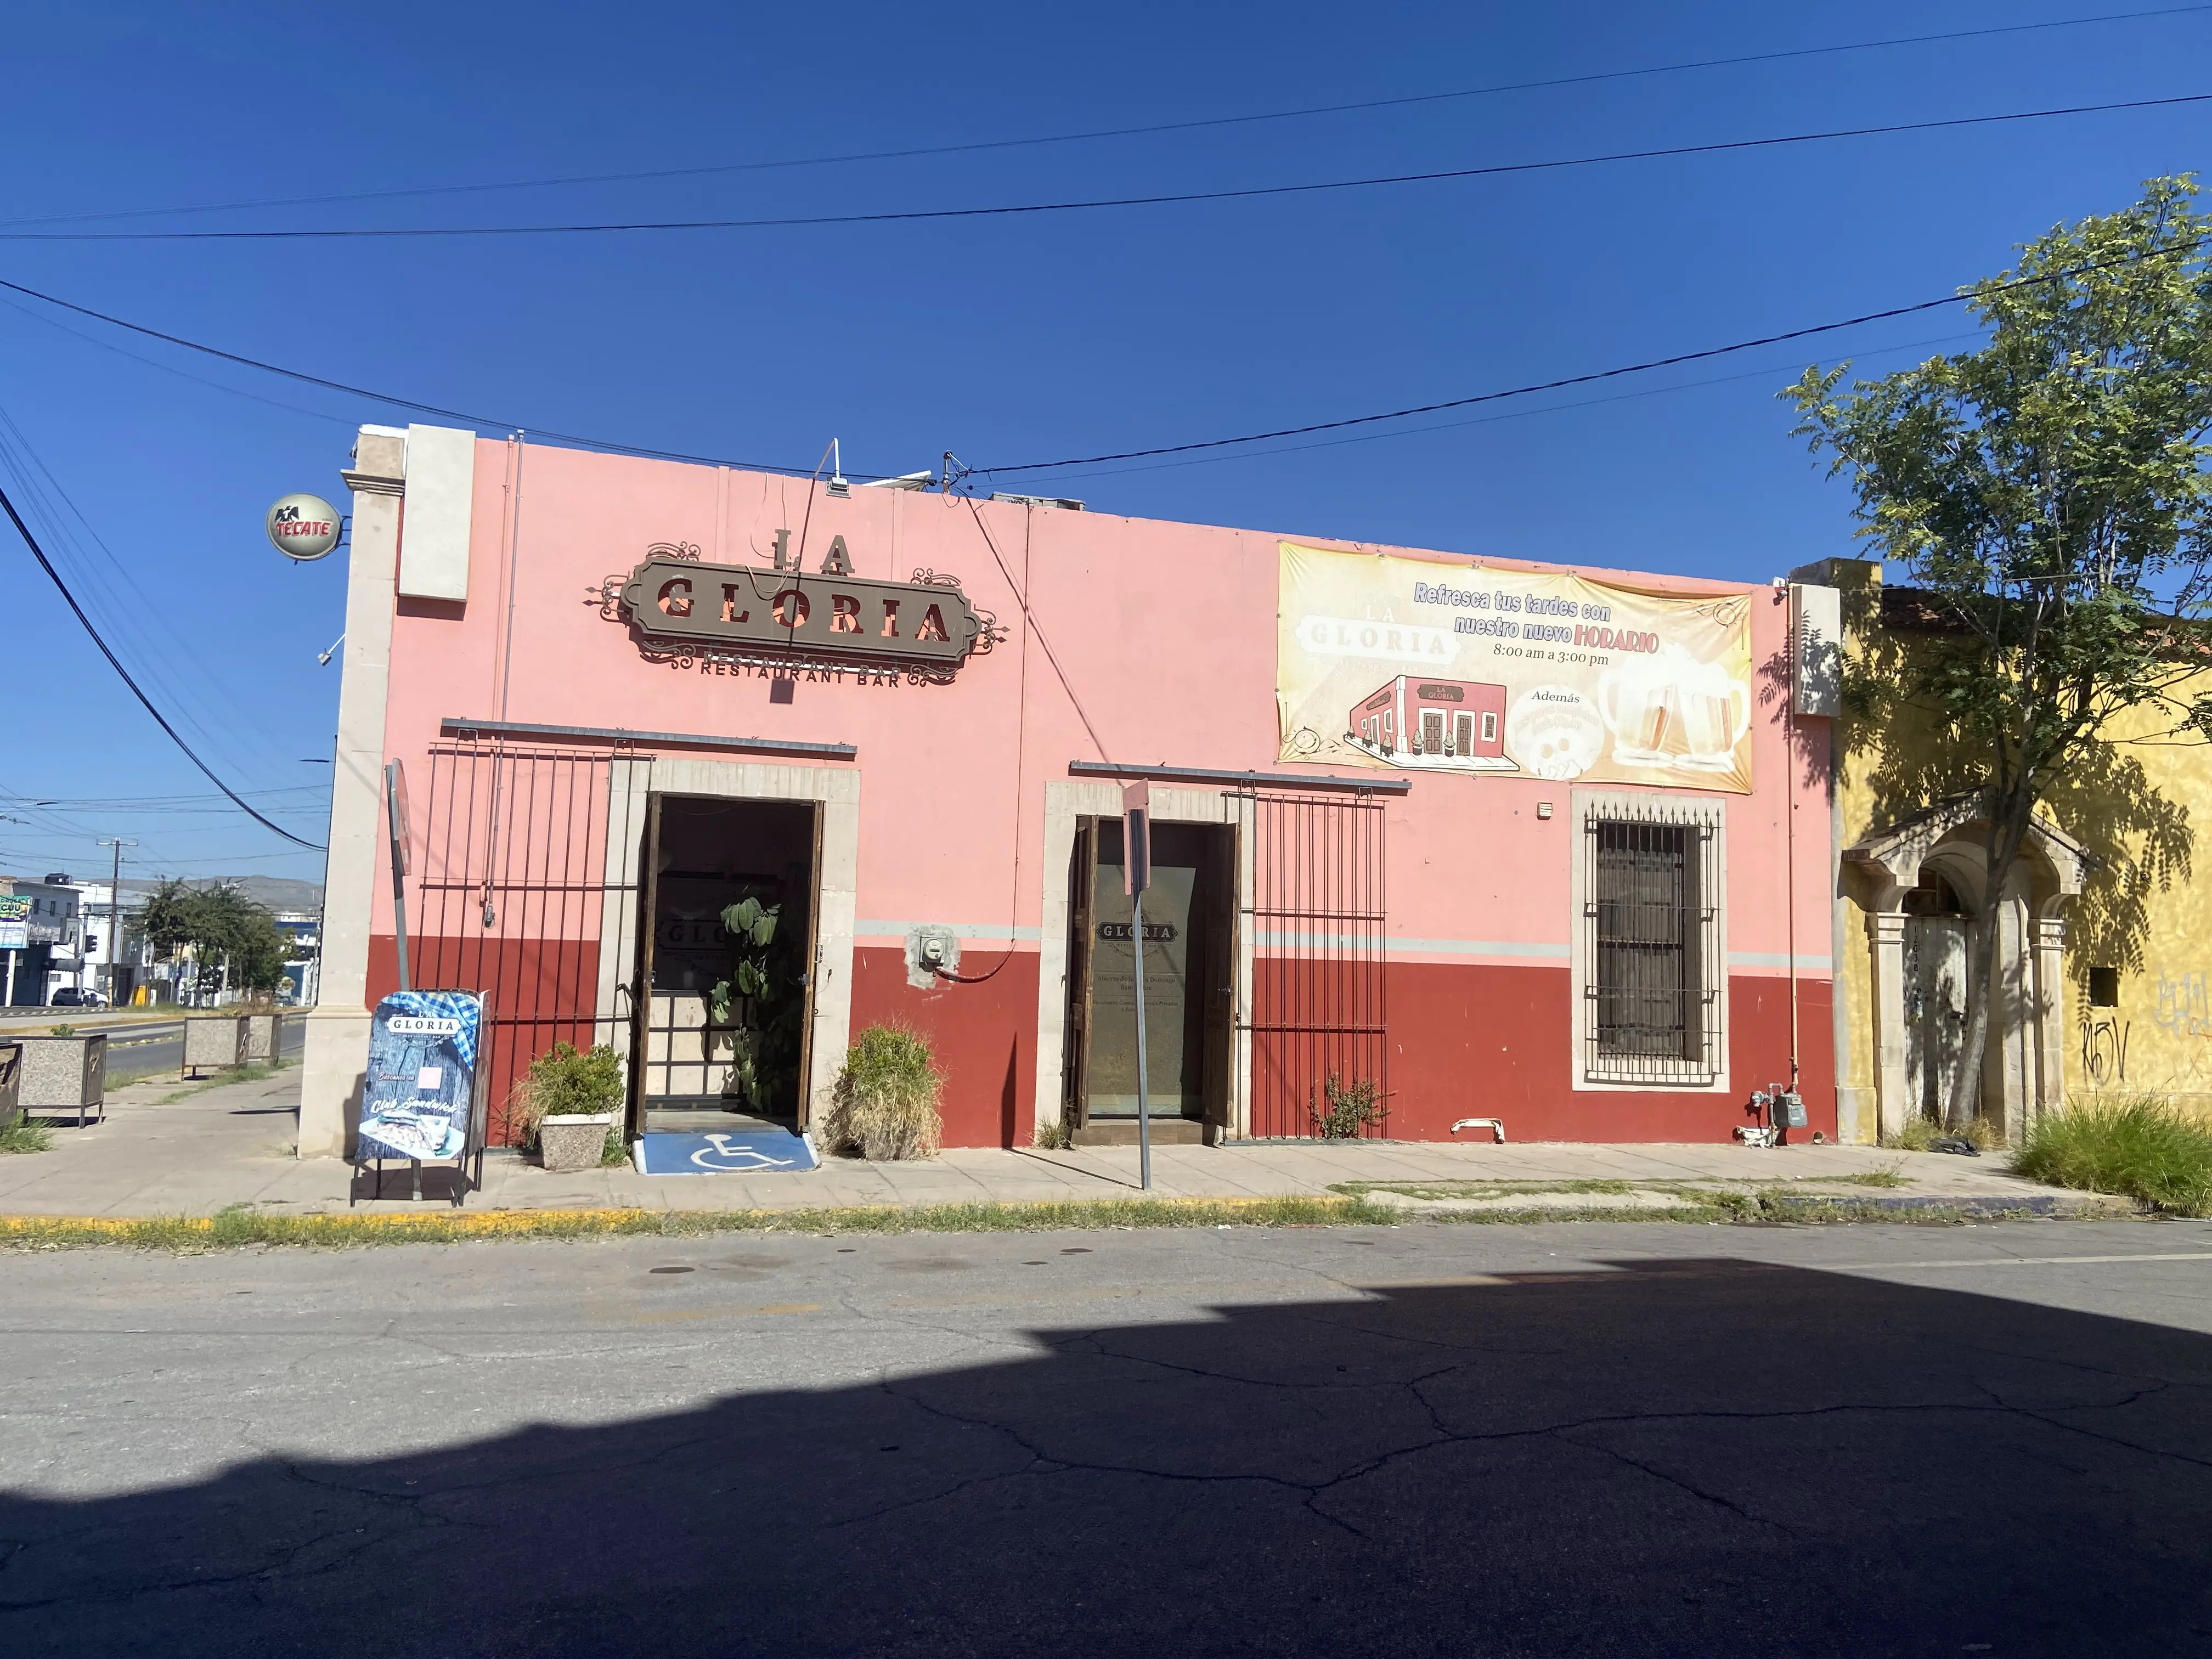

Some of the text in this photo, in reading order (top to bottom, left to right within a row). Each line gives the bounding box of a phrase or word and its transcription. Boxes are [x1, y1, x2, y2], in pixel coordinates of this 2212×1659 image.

[275, 521, 332, 536] TECATE
[774, 529, 855, 573] LA
[658, 578, 950, 642] GLORIA
[1365, 605, 1395, 622] LA
[1414, 582, 1611, 622] Refresca tus tardes con
[1311, 623, 1446, 654] GLORIA
[1454, 617, 1659, 654] nuestro nuevo HORARIO
[703, 651, 902, 679] RESTAURANT BAR
[1493, 643, 1609, 667] 8:00 am a 3:00 pm
[1428, 692, 1454, 701] GLORIA
[1532, 691, 1580, 703] Además
[394, 1020, 454, 1030] GLORIA
[370, 1096, 458, 1114] Club Sandwich
